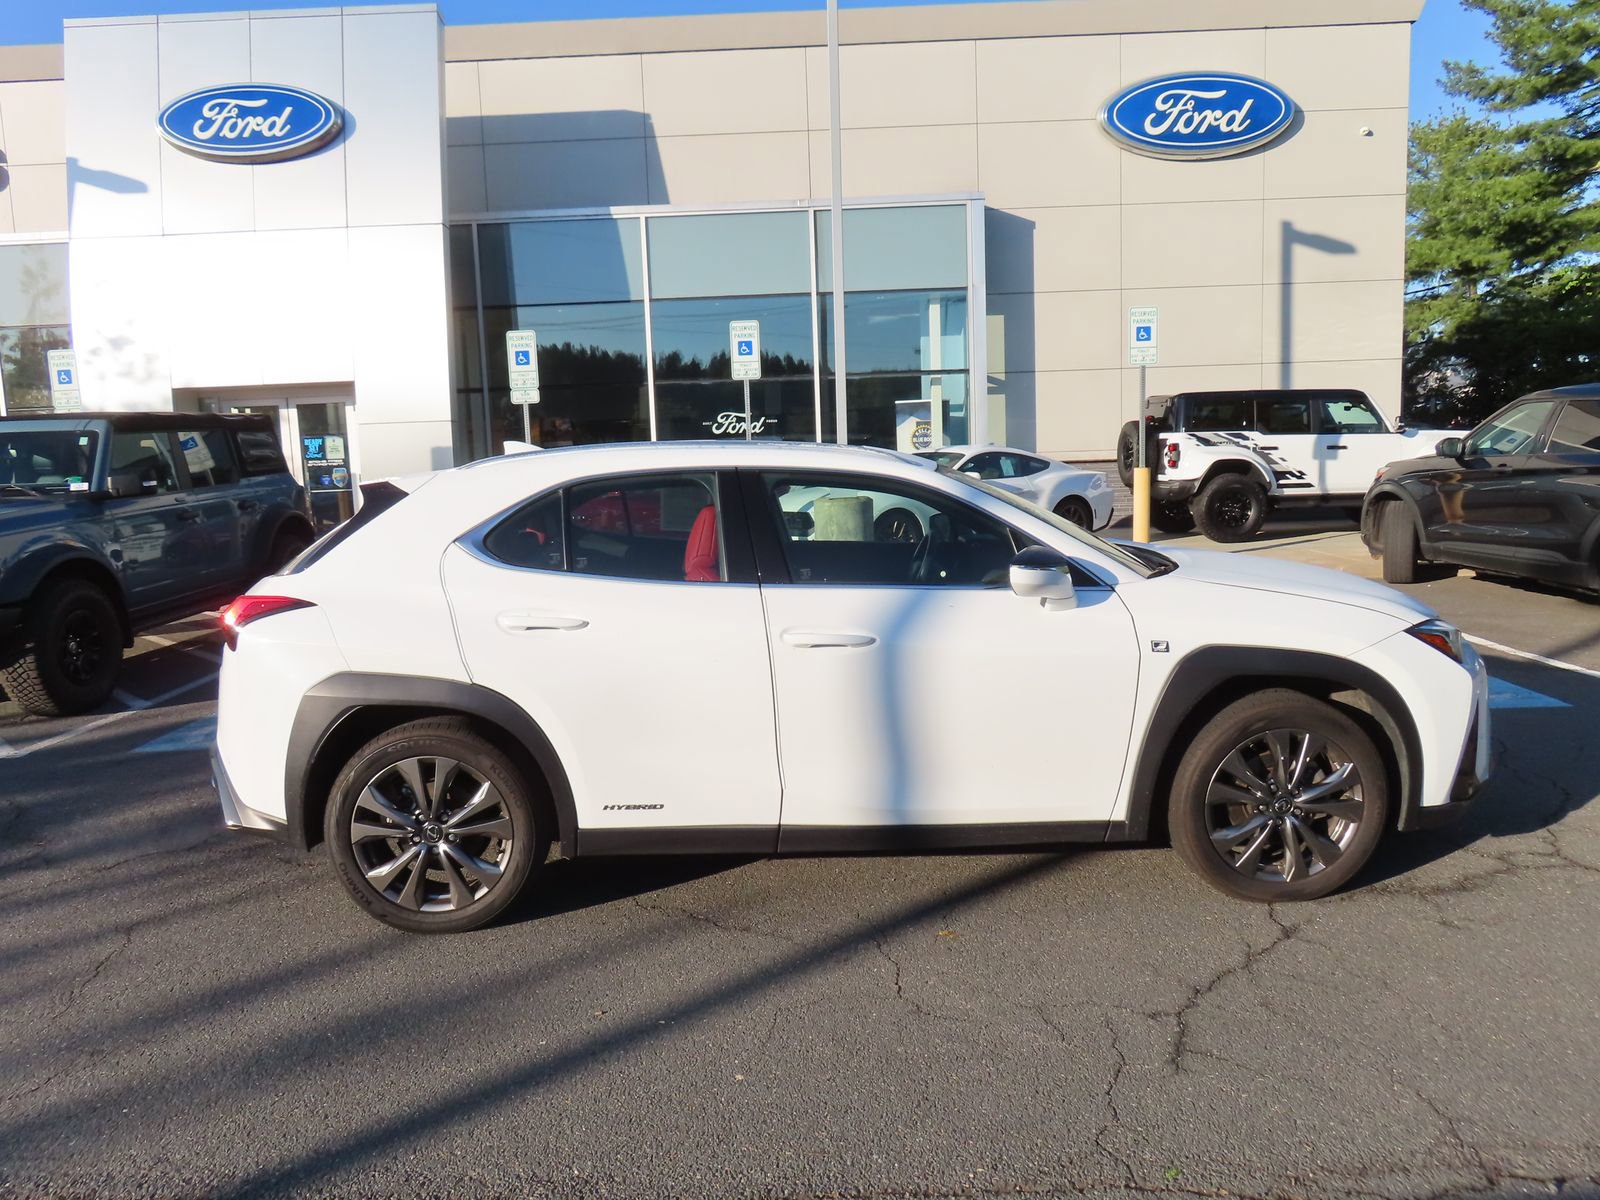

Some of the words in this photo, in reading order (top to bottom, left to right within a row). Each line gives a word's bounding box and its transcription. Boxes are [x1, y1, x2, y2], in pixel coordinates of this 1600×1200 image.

[193, 98, 293, 140] Ford
[1144, 89, 1254, 136] Ford
[1131, 310, 1156, 318] RESERVED
[732, 324, 756, 332] RESERVED
[712, 412, 766, 434] Ford
